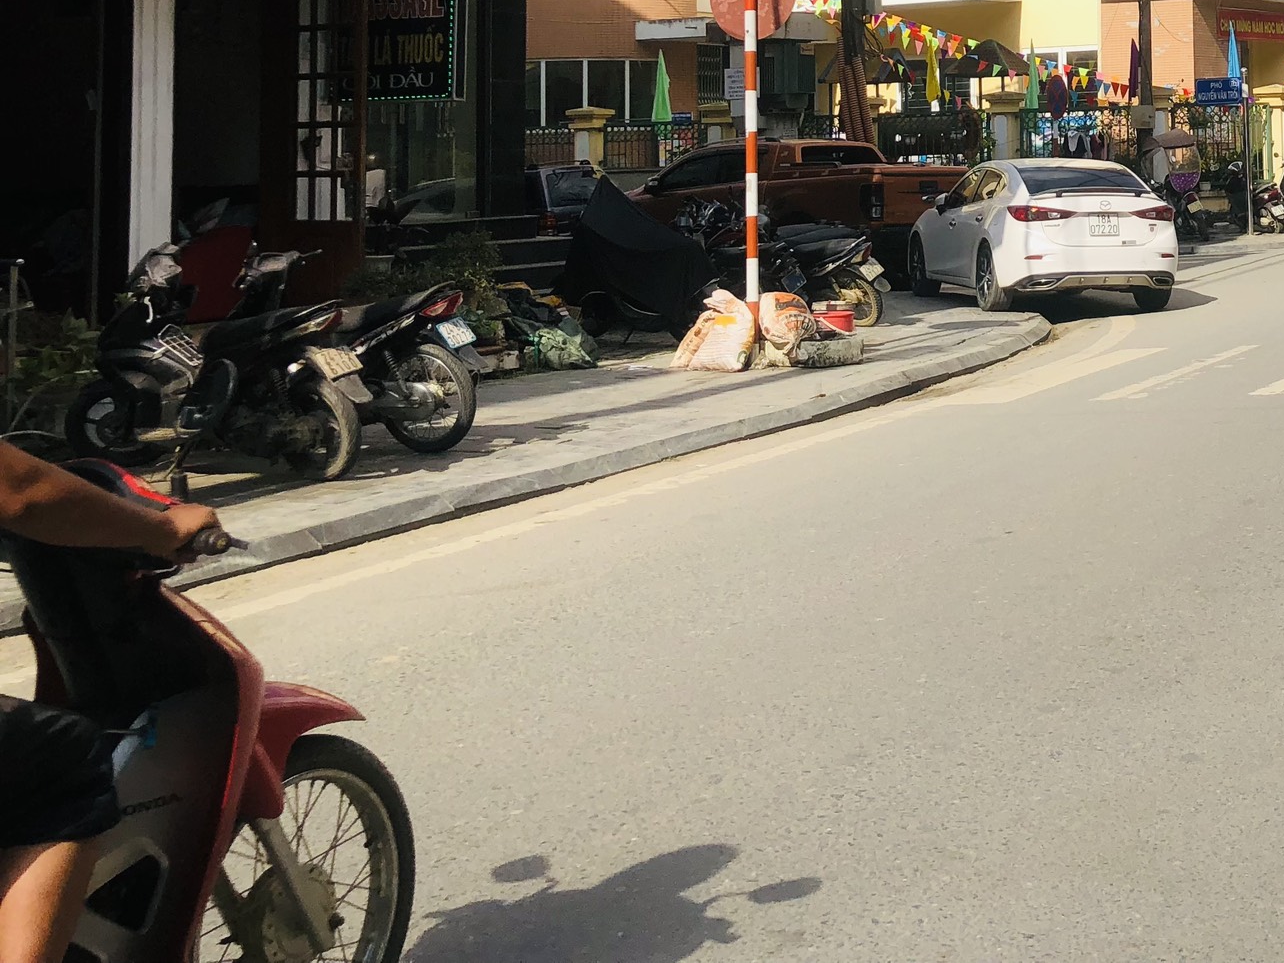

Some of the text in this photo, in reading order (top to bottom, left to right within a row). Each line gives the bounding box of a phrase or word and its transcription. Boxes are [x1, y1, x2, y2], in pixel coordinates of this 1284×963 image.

[1220, 18, 1235, 32] CHO
[388, 66, 434, 89] ĐẦU
[1096, 214, 1112, 224] 18A
[122, 793, 184, 815] ONDA
